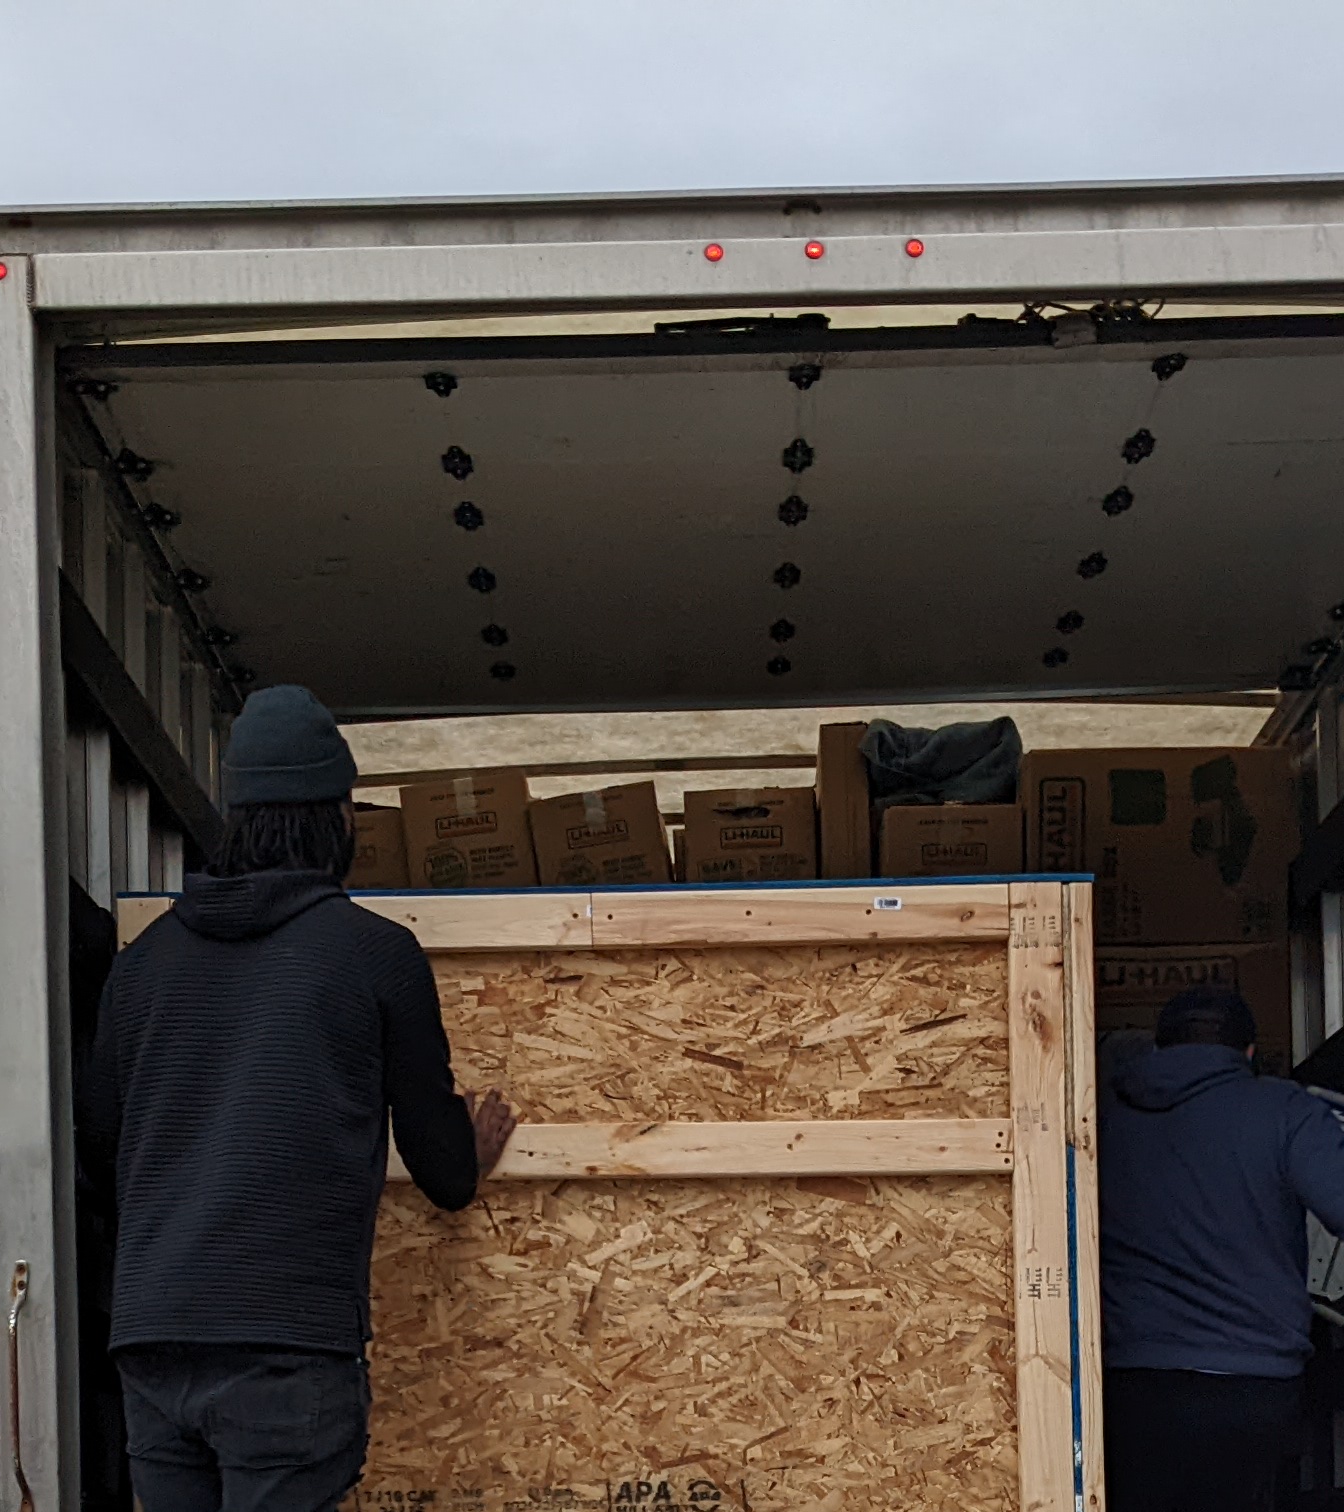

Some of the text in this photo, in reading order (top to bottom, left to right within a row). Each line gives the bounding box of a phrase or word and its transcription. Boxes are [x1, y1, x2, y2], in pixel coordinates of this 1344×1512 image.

[723, 828, 777, 841] U-HAUL
[1098, 962, 1234, 986] U-HAUL
[614, 1480, 671, 1504] APA
